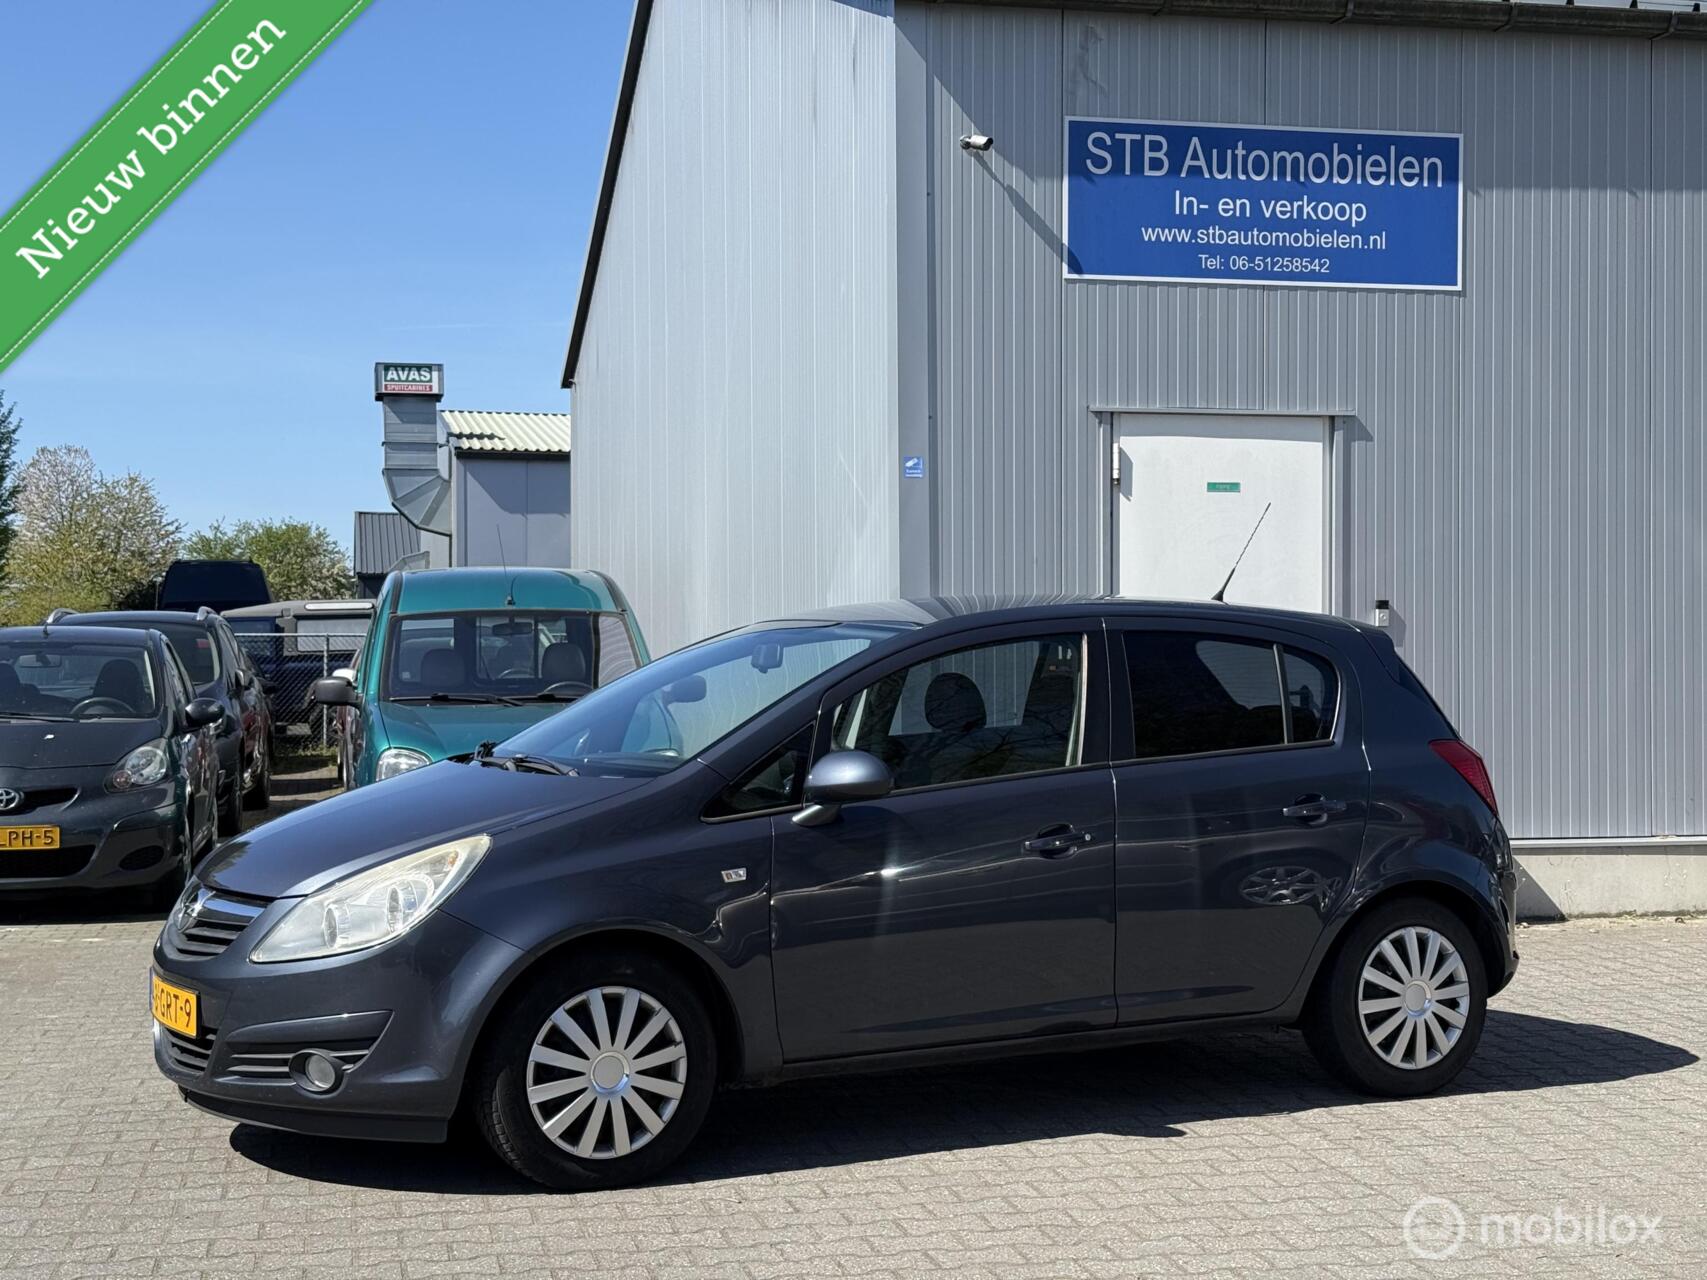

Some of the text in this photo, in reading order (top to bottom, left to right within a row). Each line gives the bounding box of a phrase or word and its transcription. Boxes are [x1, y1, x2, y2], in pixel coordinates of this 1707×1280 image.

[1085, 131, 1443, 188] STB Automobielen
[1174, 190, 1367, 227] In- en verkoop
[1141, 225, 1387, 250] www.stbautomobielen.nl
[1198, 254, 1330, 273] Tel: 06-51258542
[386, 366, 431, 381] AVAS
